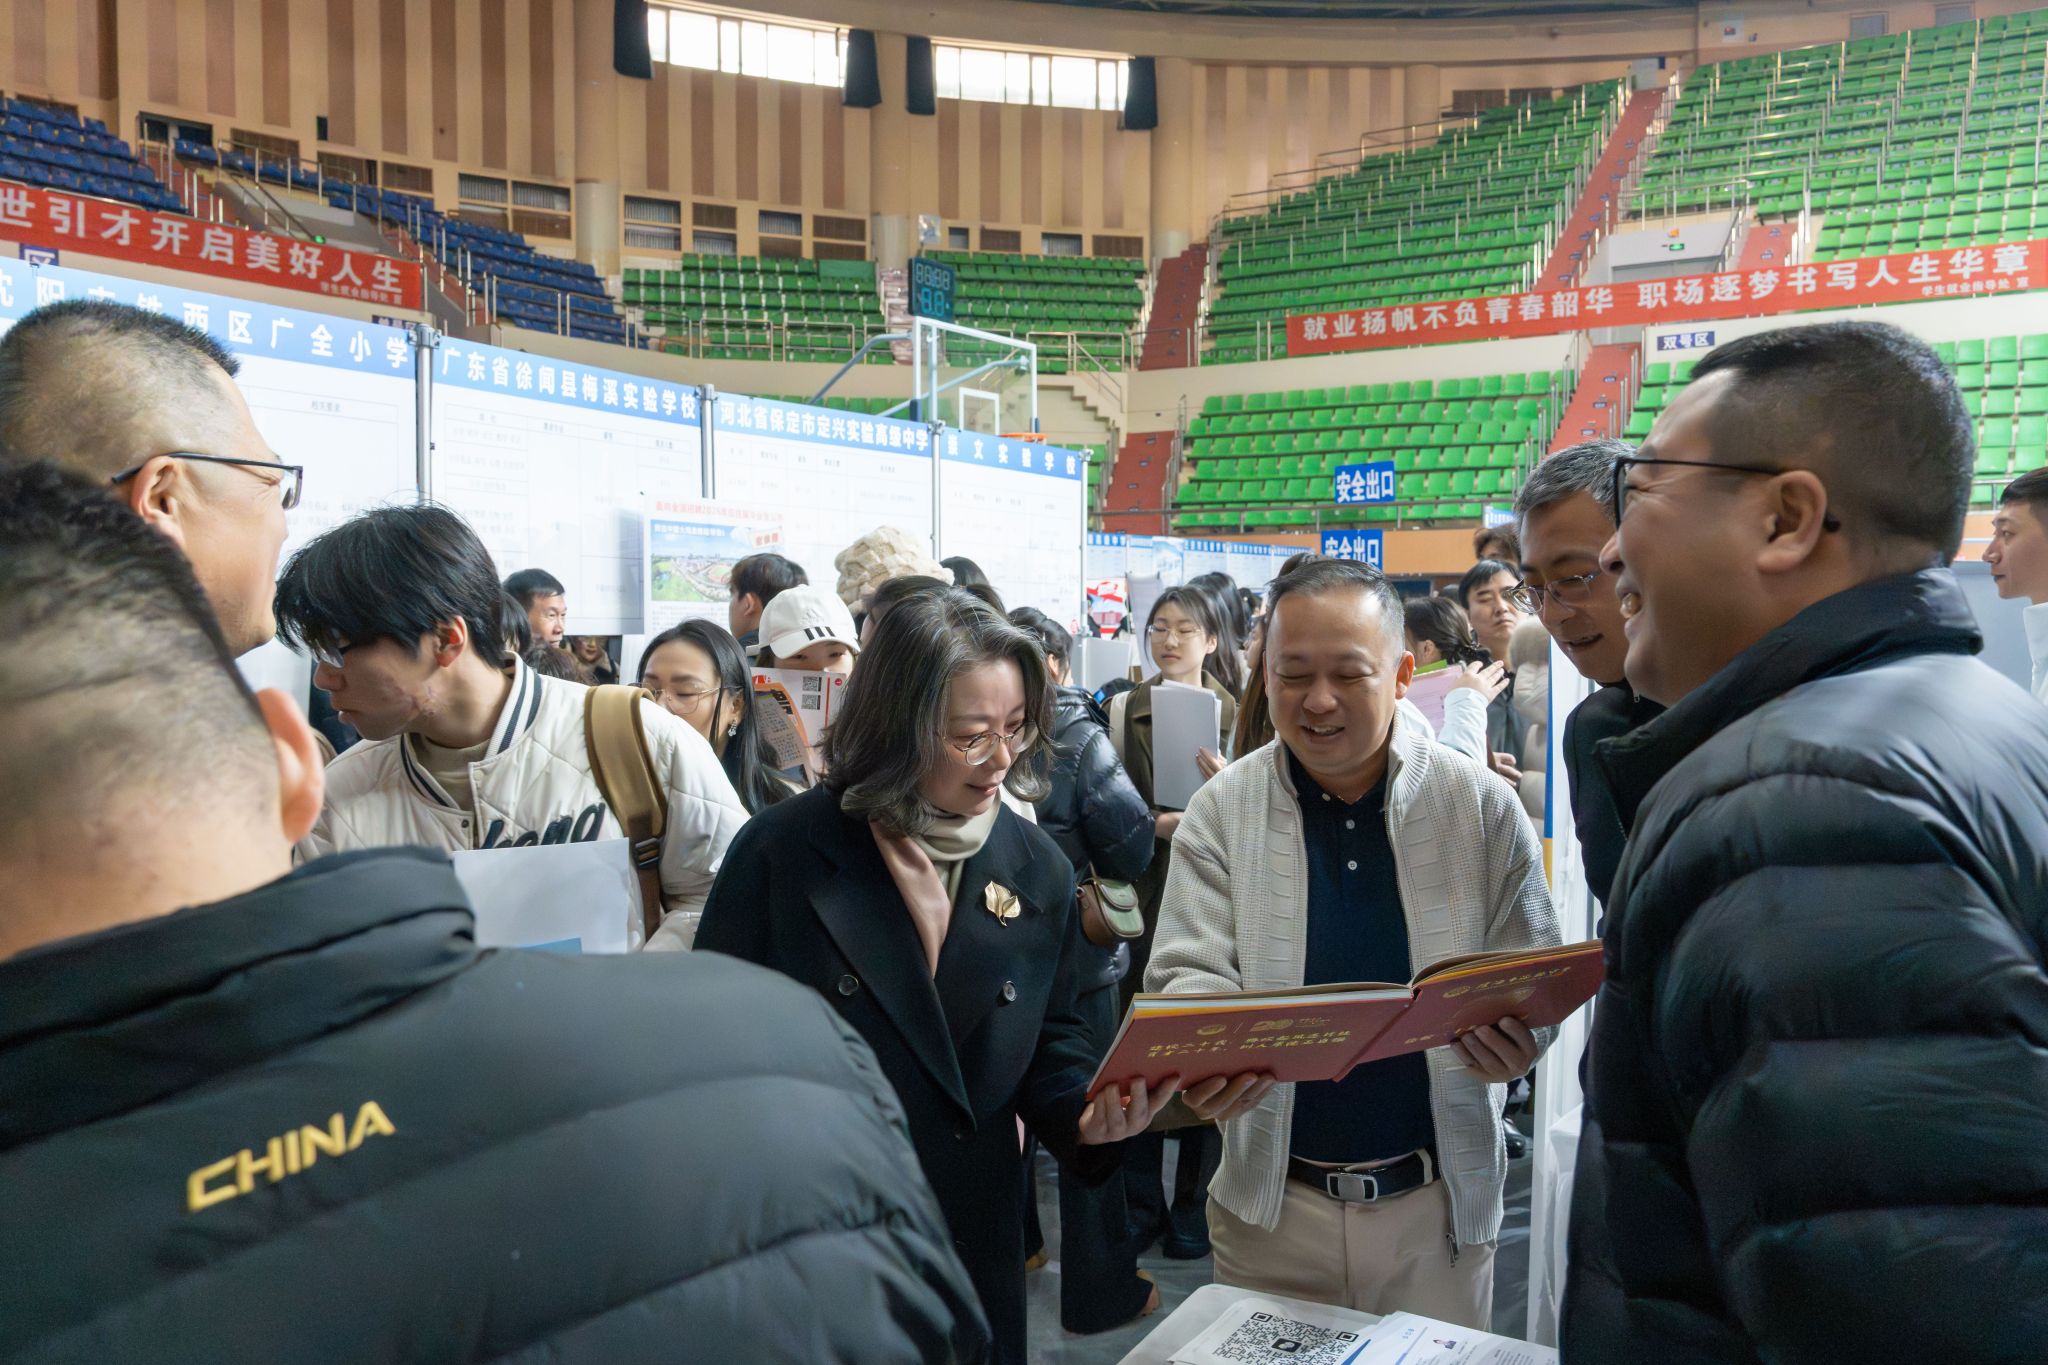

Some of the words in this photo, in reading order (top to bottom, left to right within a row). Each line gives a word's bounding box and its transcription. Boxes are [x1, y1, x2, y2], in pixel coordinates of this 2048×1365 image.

[0, 188, 402, 293] 世引才开启美好人生
[1303, 287, 1614, 341] 就业扬帆不负青春韶华
[1637, 245, 2030, 310] 职场逐梦书写人生华章
[1663, 332, 1712, 350] 双号区
[441, 346, 696, 420] 广东省徐闻县梅溪实验学校
[721, 401, 929, 452] 河北省保定市定兴实验高级中学
[1337, 469, 1394, 503] 安全出口
[187, 1100, 396, 1212] CHINA
